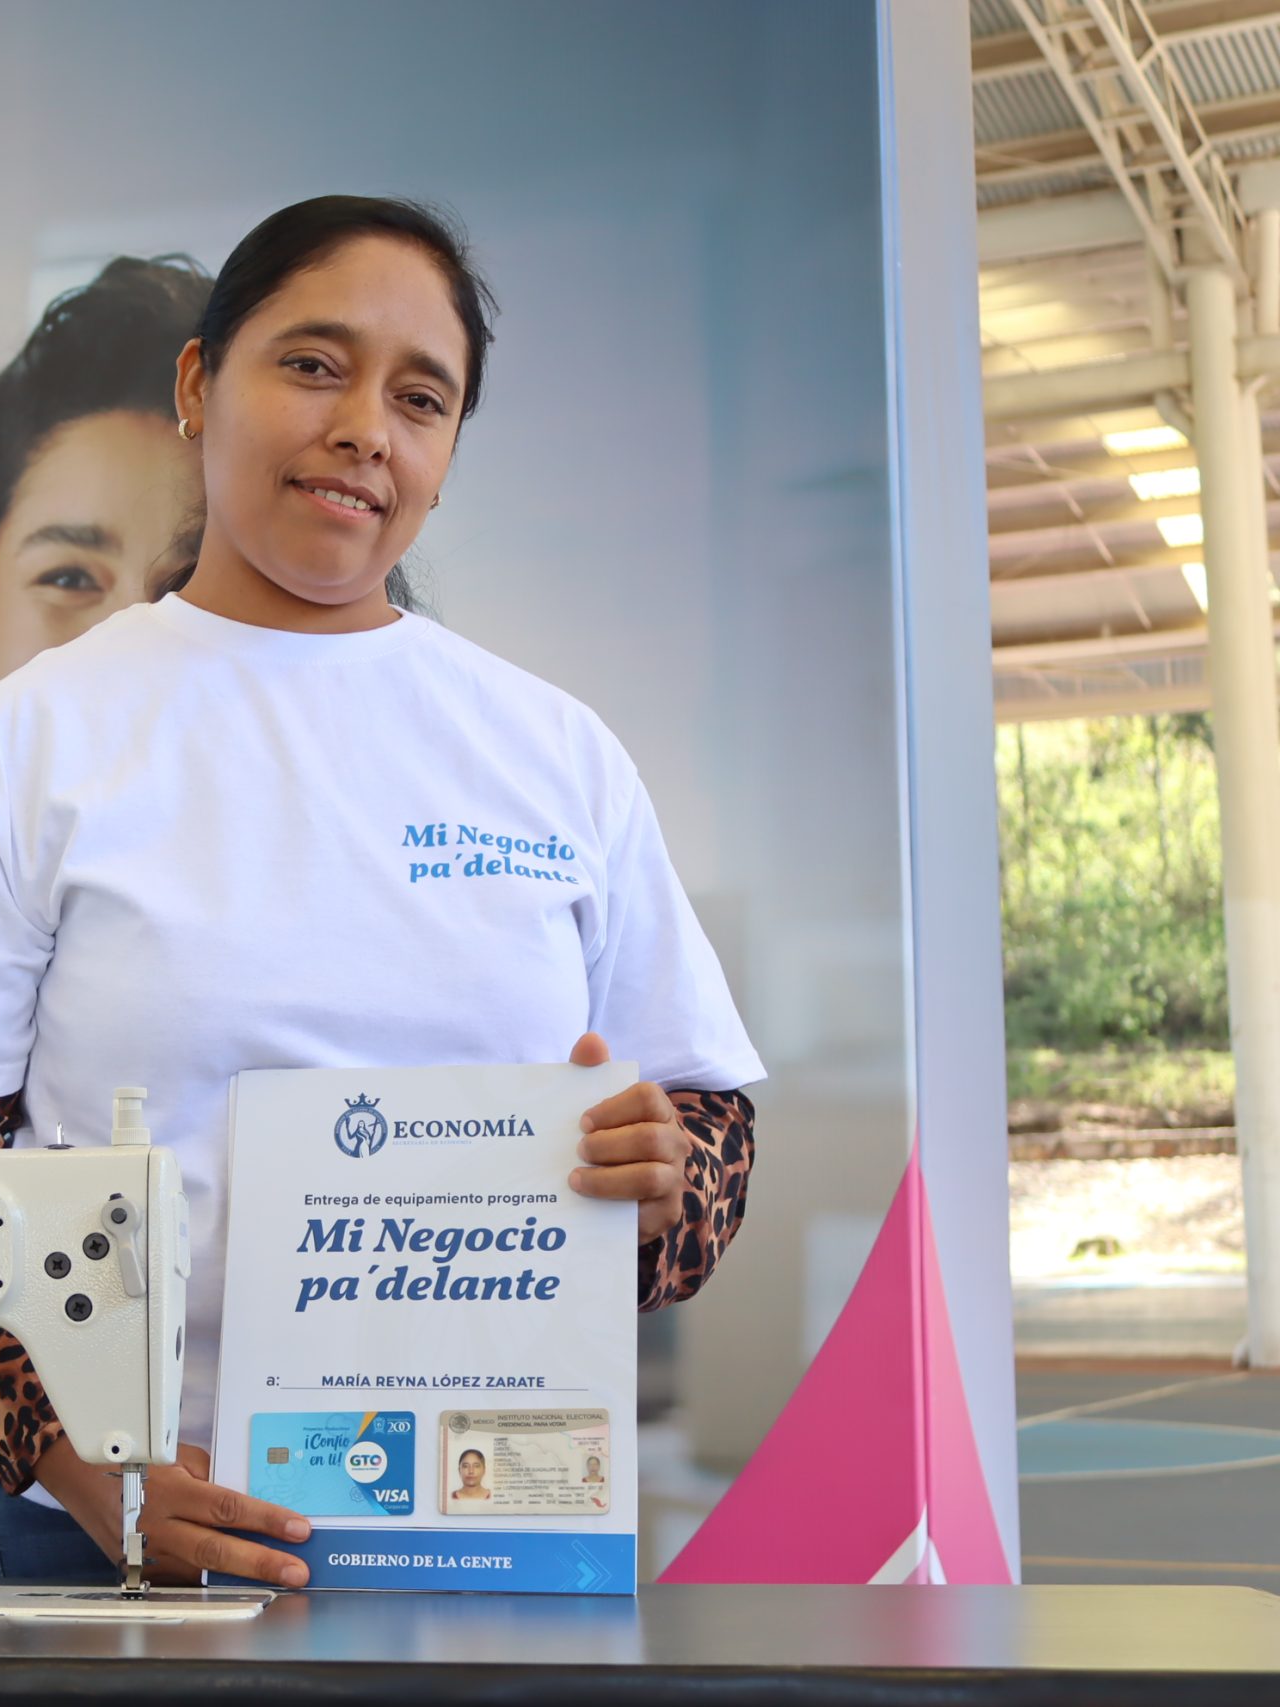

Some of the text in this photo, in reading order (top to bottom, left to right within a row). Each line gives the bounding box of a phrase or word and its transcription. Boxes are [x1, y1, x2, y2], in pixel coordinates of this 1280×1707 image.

[401, 823, 575, 861] Mi Negocio
[393, 1115, 535, 1138] ECONOMÍA
[304, 1193, 557, 1207] Entrega de equipamiento programa
[296, 1216, 567, 1263] Mi Negocio
[266, 1373, 545, 1387] a: MARÍA REYNA LÓPEZ ZARATE
[309, 1452, 342, 1467] en ti!
[350, 1454, 382, 1466] GTO
[372, 1489, 410, 1502] VISA
[328, 1553, 513, 1569] GOBIERNO DE LA GENTE
